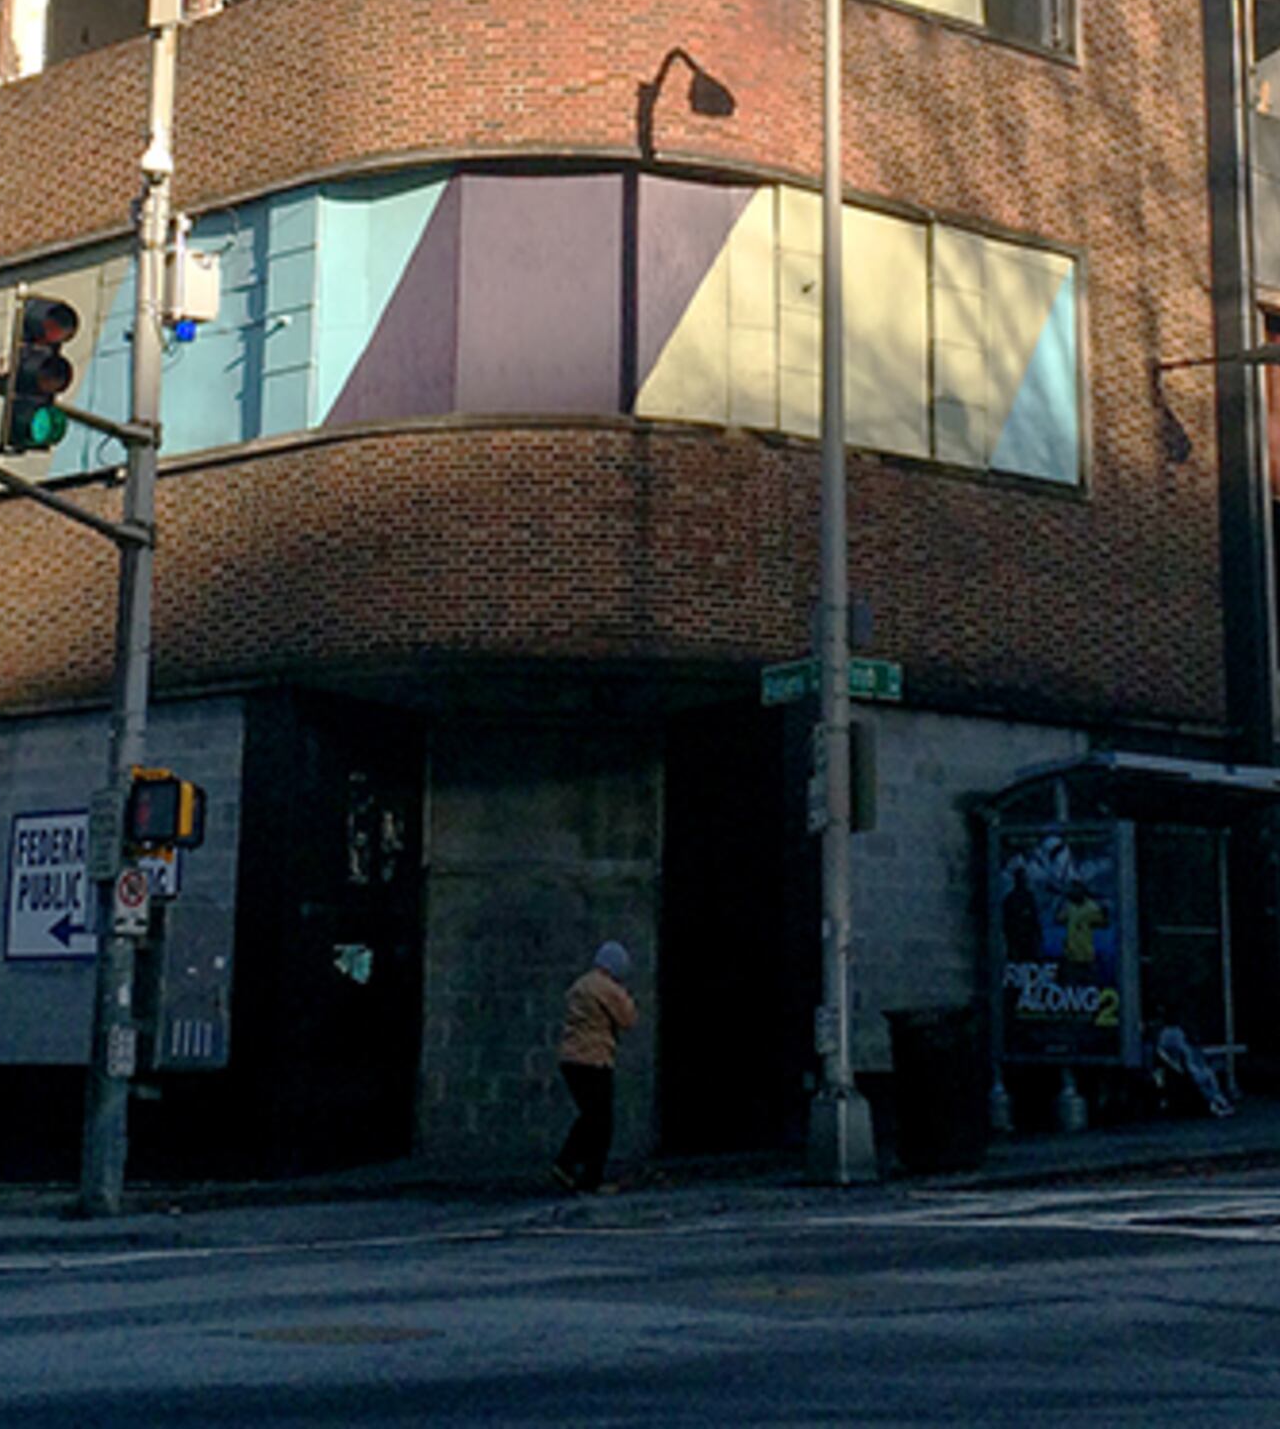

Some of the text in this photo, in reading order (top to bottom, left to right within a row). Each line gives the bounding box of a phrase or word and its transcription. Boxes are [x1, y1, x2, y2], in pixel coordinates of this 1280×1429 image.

[18, 827, 86, 865] FEDERA
[17, 871, 82, 911] PUBLIC
[1015, 981, 1120, 1027] ALONG 2
